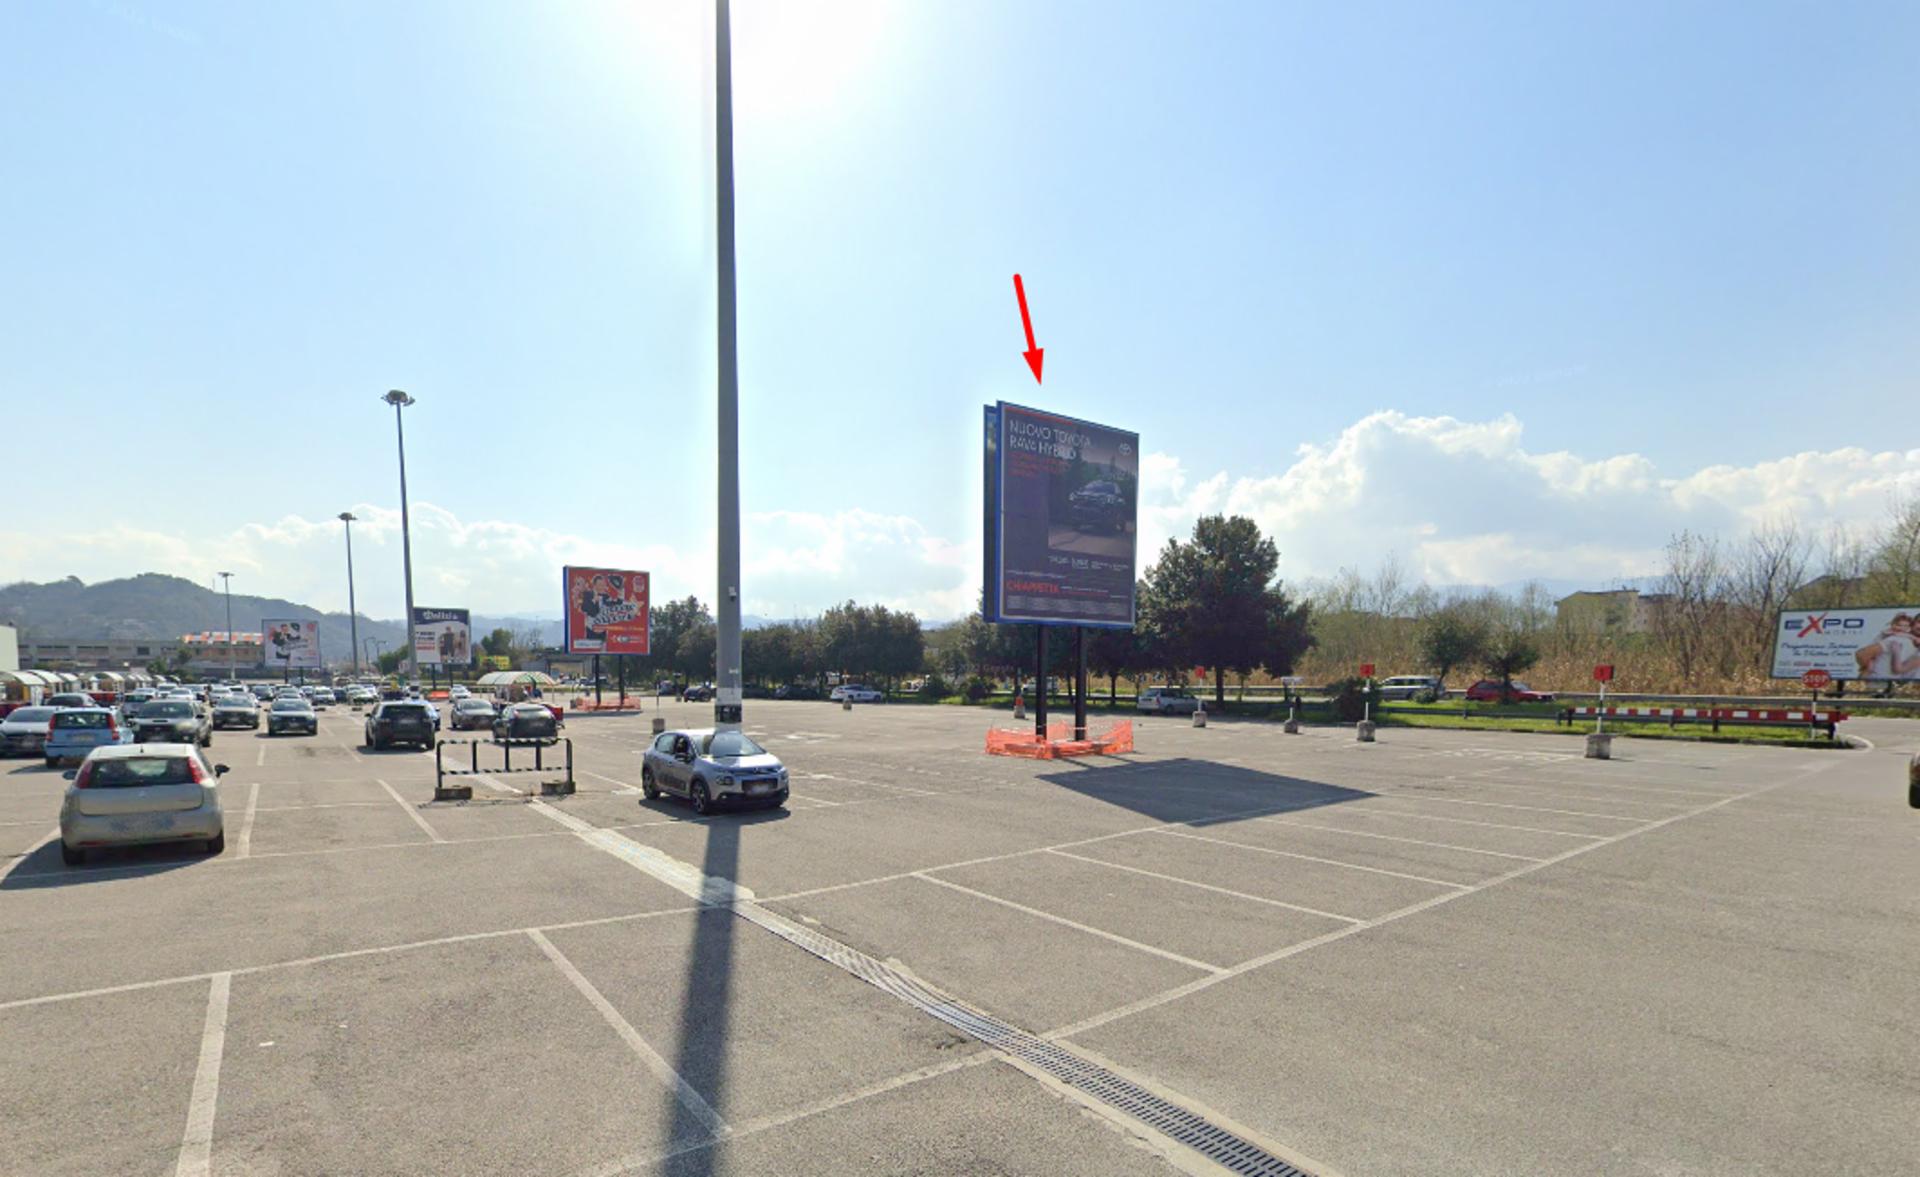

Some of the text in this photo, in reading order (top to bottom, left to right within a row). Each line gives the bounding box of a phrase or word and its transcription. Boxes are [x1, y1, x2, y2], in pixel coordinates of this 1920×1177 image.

[1009, 419, 1091, 448] NUOVO TOYOTA
[1038, 440, 1076, 459] HYBRID
[1784, 612, 1865, 638] EXPO
[1804, 674, 1828, 683] STOP
